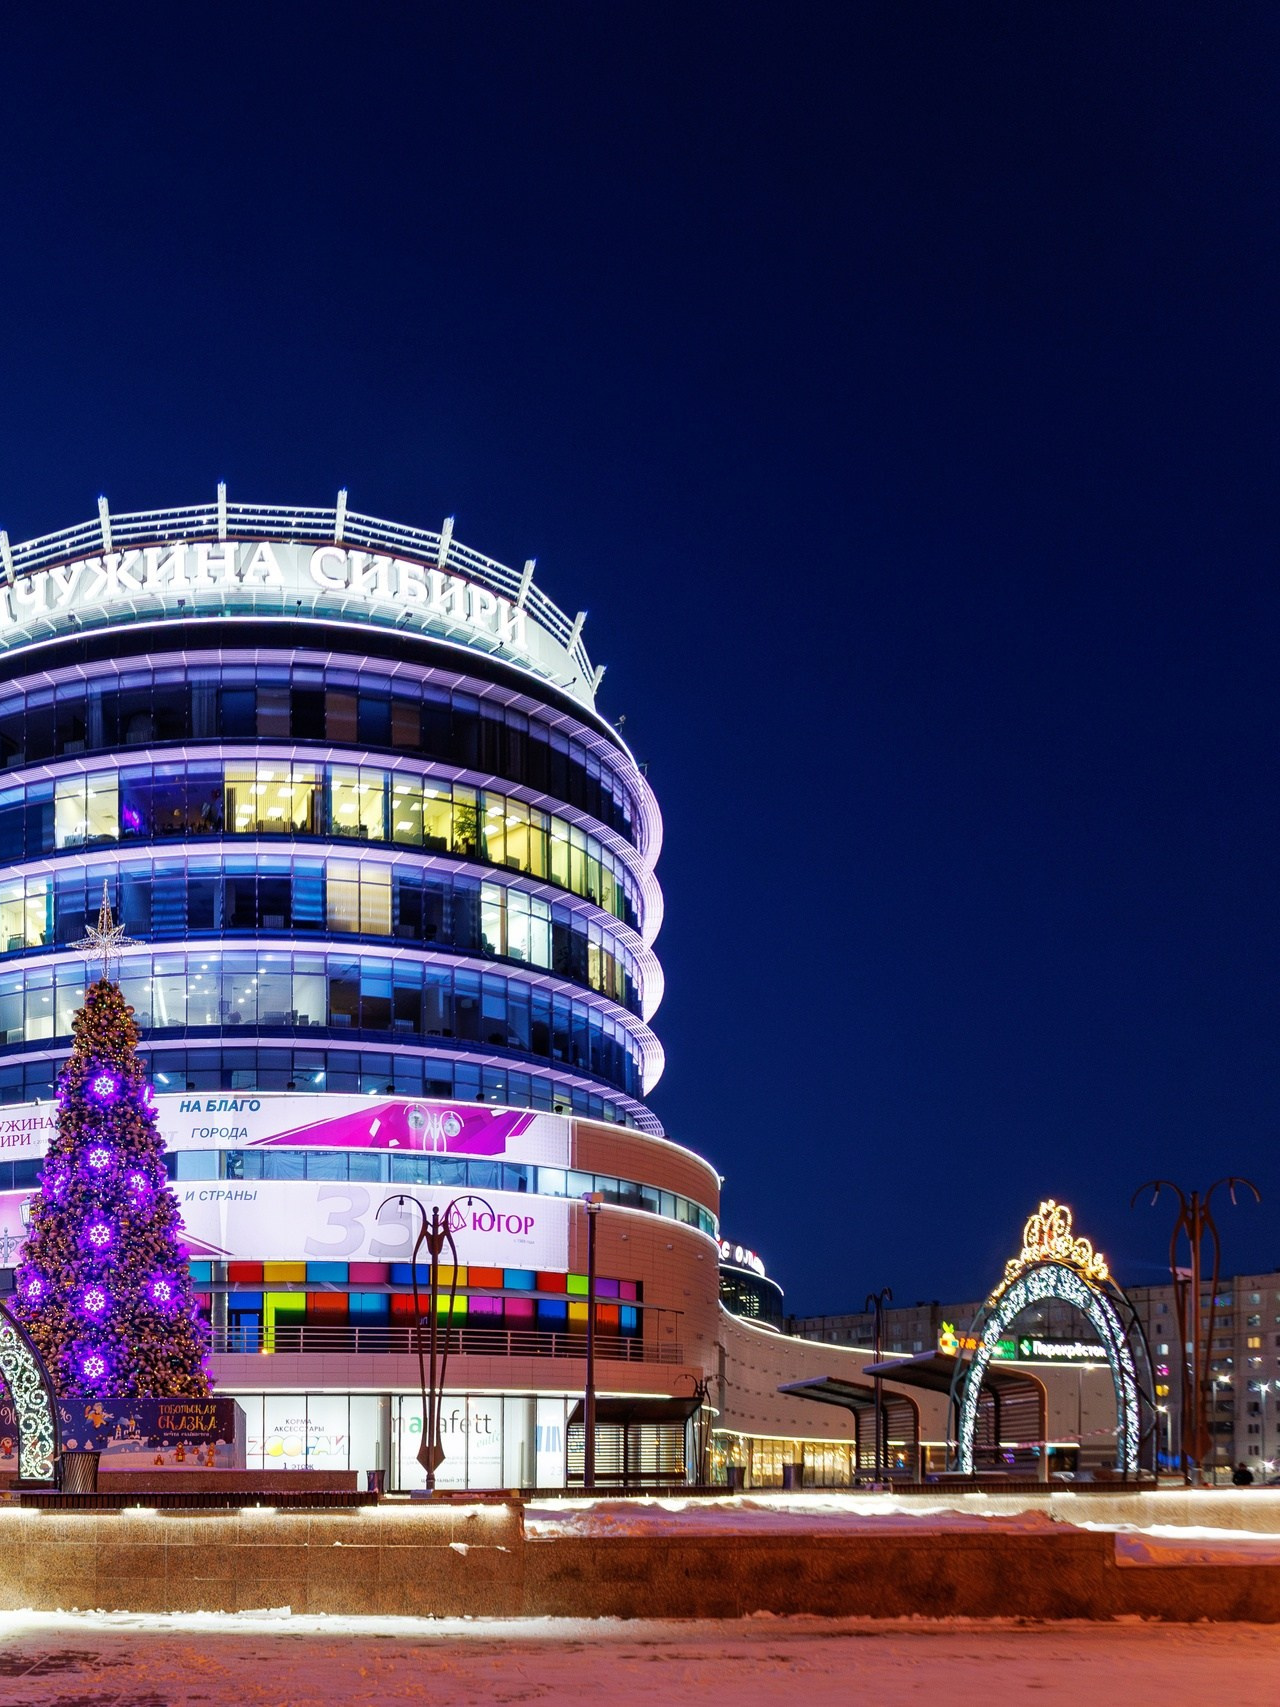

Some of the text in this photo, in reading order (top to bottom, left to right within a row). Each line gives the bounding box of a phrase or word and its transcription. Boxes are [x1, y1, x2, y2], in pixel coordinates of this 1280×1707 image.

[310, 546, 528, 649] СИБИРИ
[180, 1100, 261, 1112] НА БЛАГО
[191, 1128, 248, 1139] ГОРОДА
[185, 1190, 258, 1201] И СТРАНЫ
[473, 1212, 535, 1235] ЮГОР
[159, 1404, 217, 1415] ТОБОЛЬСКАЯ
[158, 1415, 218, 1431] СКАЗКА
